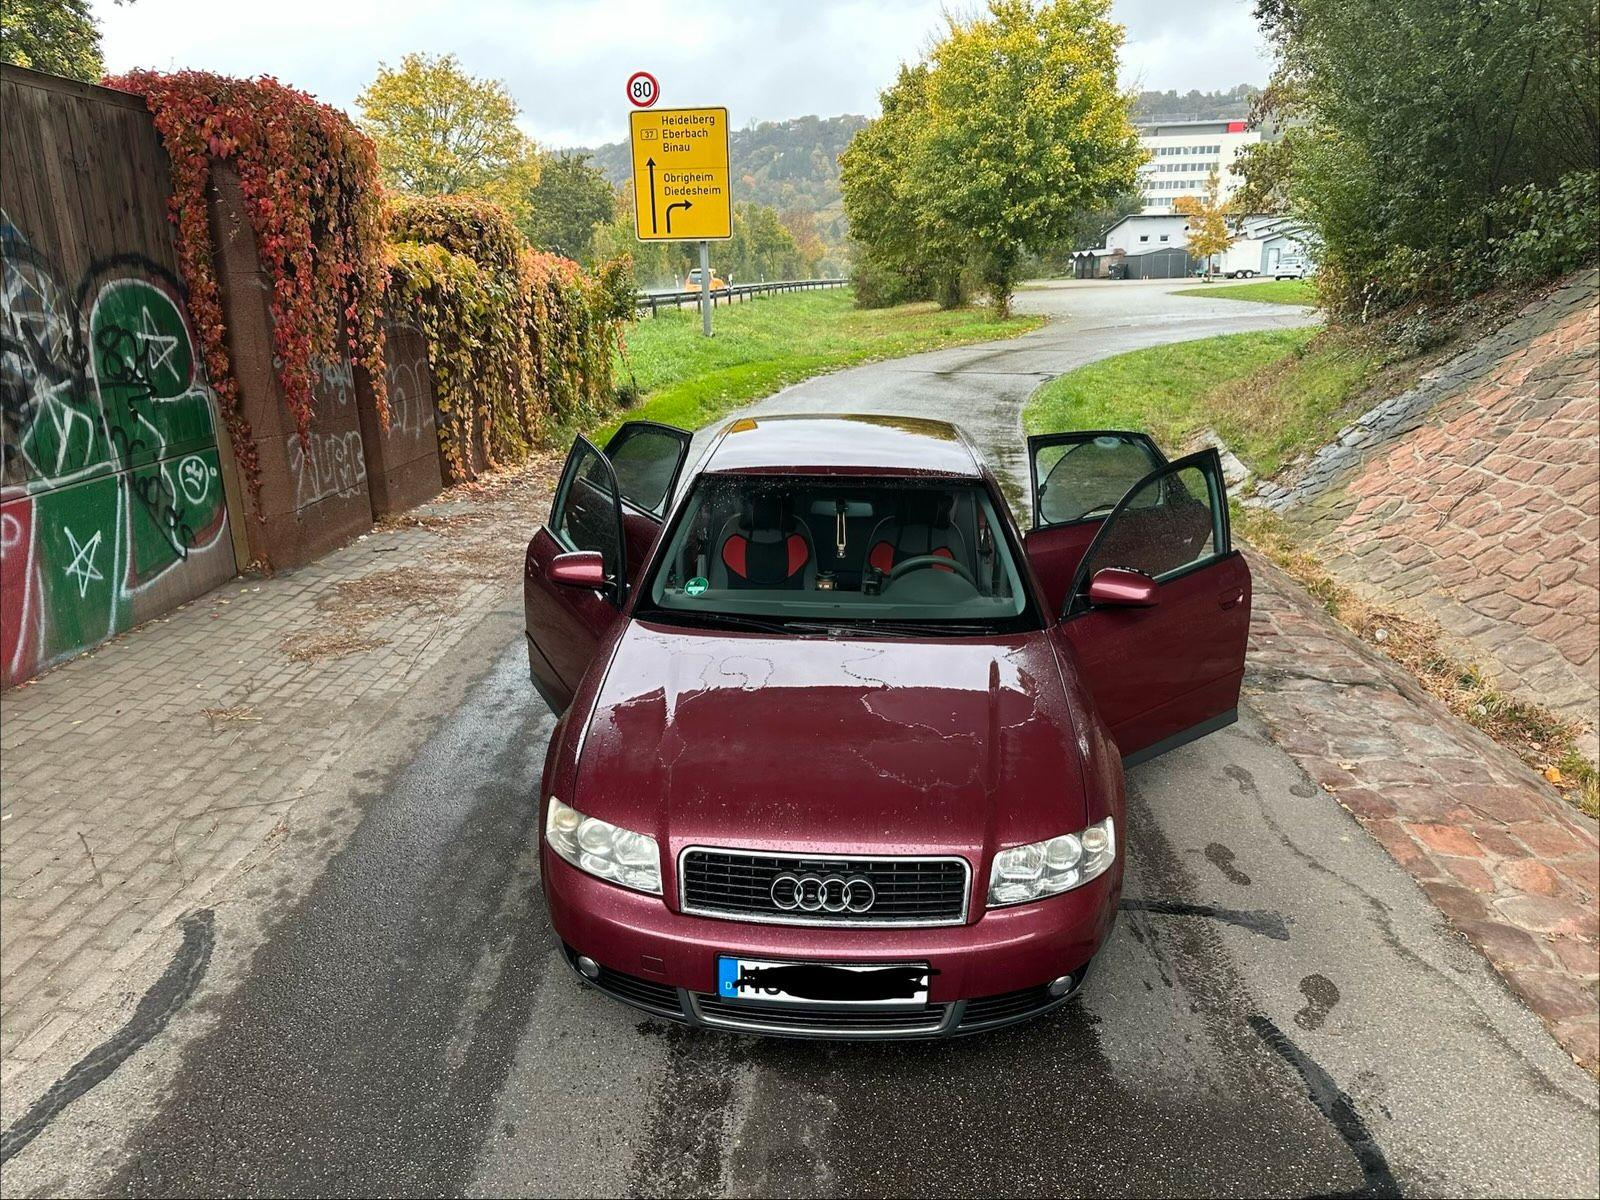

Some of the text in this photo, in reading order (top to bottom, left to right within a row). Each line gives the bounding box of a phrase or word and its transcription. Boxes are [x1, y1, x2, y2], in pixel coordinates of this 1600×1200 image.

[633, 81, 652, 98] 80
[661, 114, 715, 126] Heidelberg
[644, 128, 708, 139] 37 Eberbach
[663, 143, 690, 152] Binau
[663, 172, 714, 184] Obrigheim
[664, 186, 721, 196] Diedesheim
[725, 981, 732, 990] D
